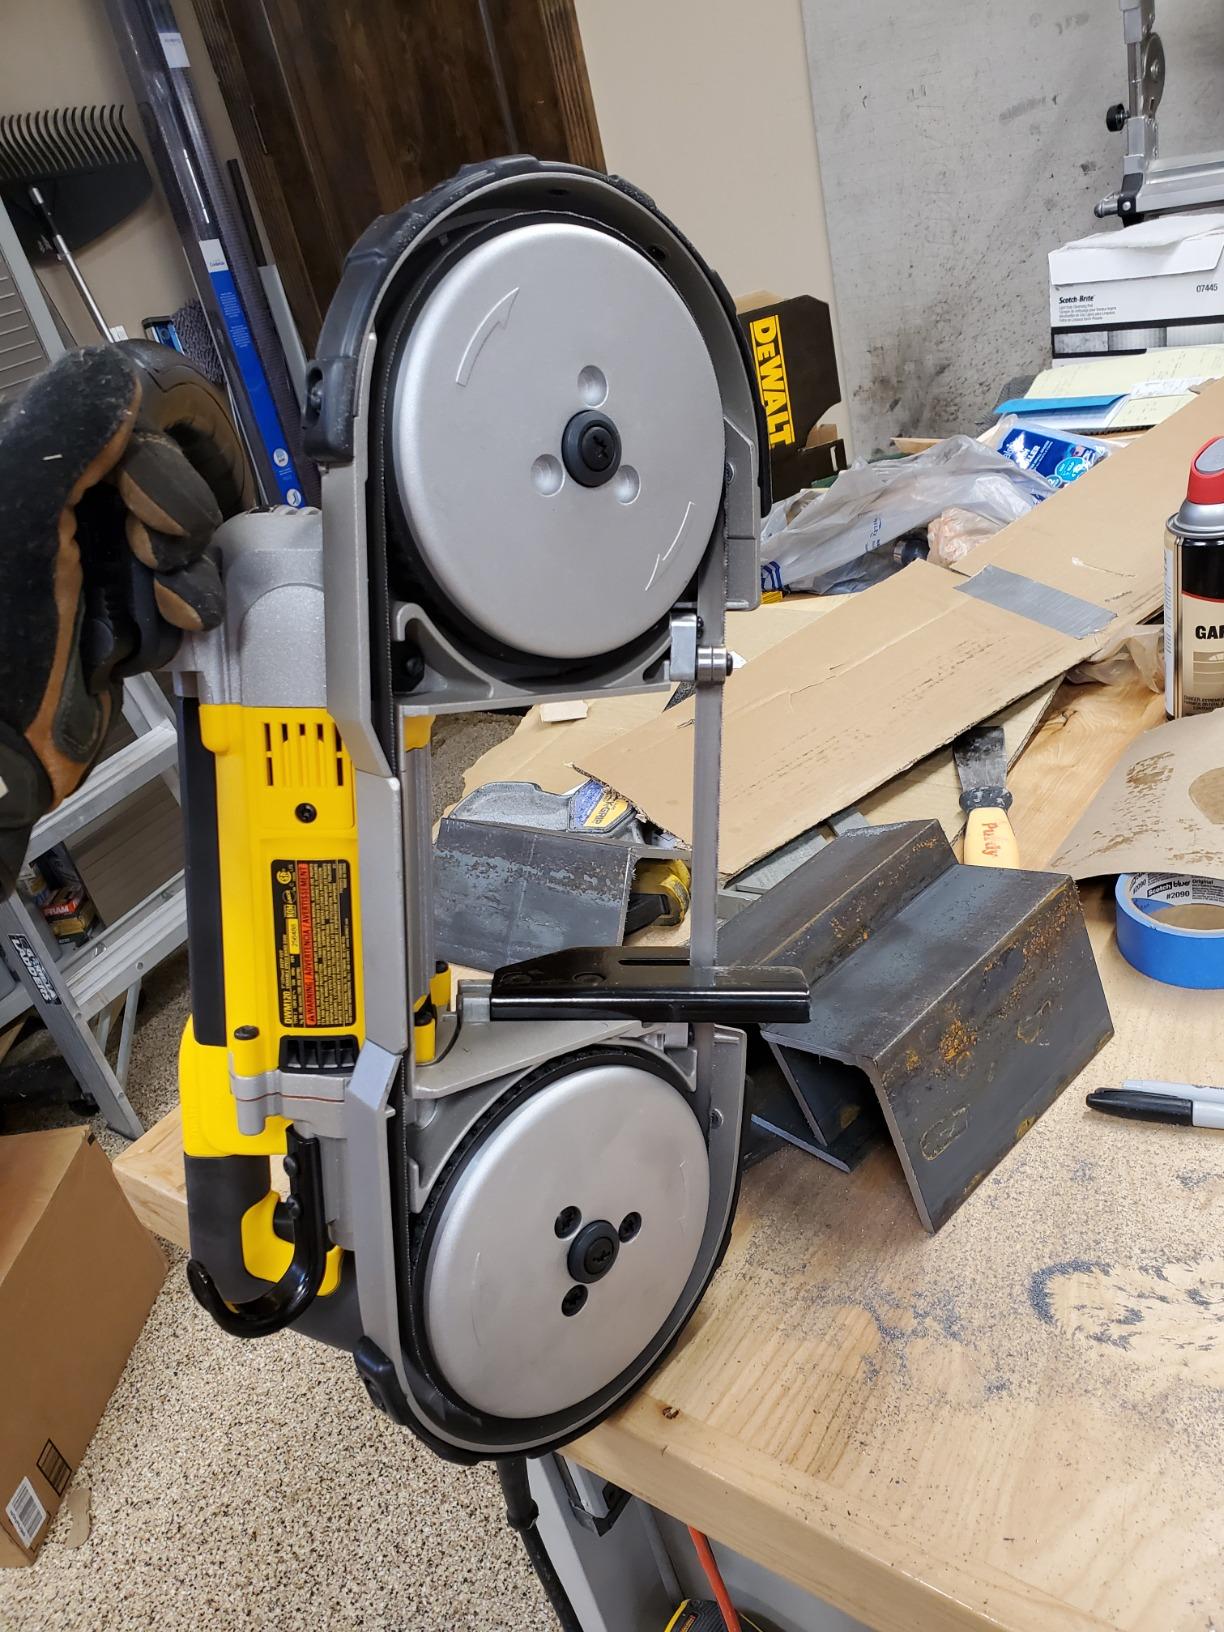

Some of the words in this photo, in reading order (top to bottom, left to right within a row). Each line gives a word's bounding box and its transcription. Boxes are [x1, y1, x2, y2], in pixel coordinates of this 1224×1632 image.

[1196, 283, 1218, 293] 07445
[753, 315, 791, 445] DEWALT
[1148, 882, 1172, 896] Scotch
[1166, 890, 1190, 899] #2090
[44, 904, 70, 915] FRAM
[12, 939, 52, 1001] LADDERS
[306, 982, 315, 1015] WARNING
